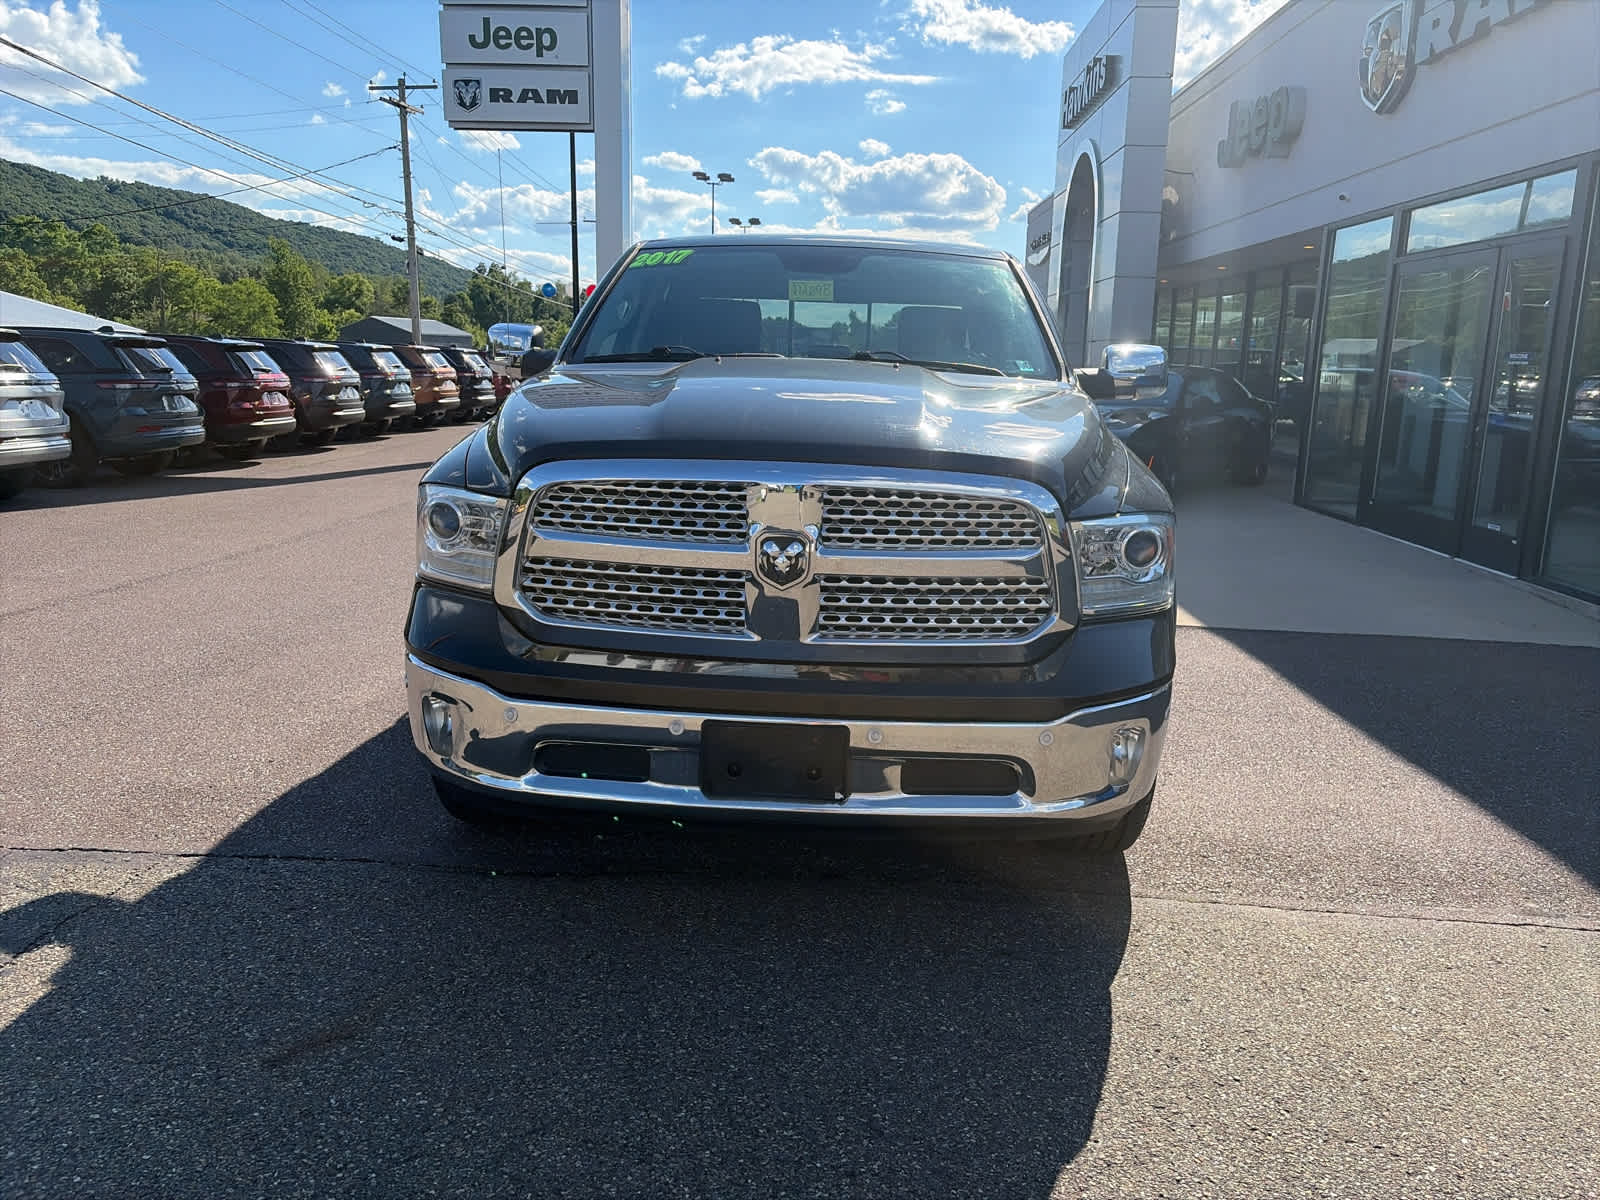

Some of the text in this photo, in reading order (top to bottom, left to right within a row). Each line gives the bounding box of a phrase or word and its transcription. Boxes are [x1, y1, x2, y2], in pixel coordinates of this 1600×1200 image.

[468, 16, 558, 58] Jeep
[1415, 0, 1537, 64] RA
[489, 87, 579, 105] RAM
[1217, 86, 1297, 166] Jeep
[628, 249, 696, 268] 2017
